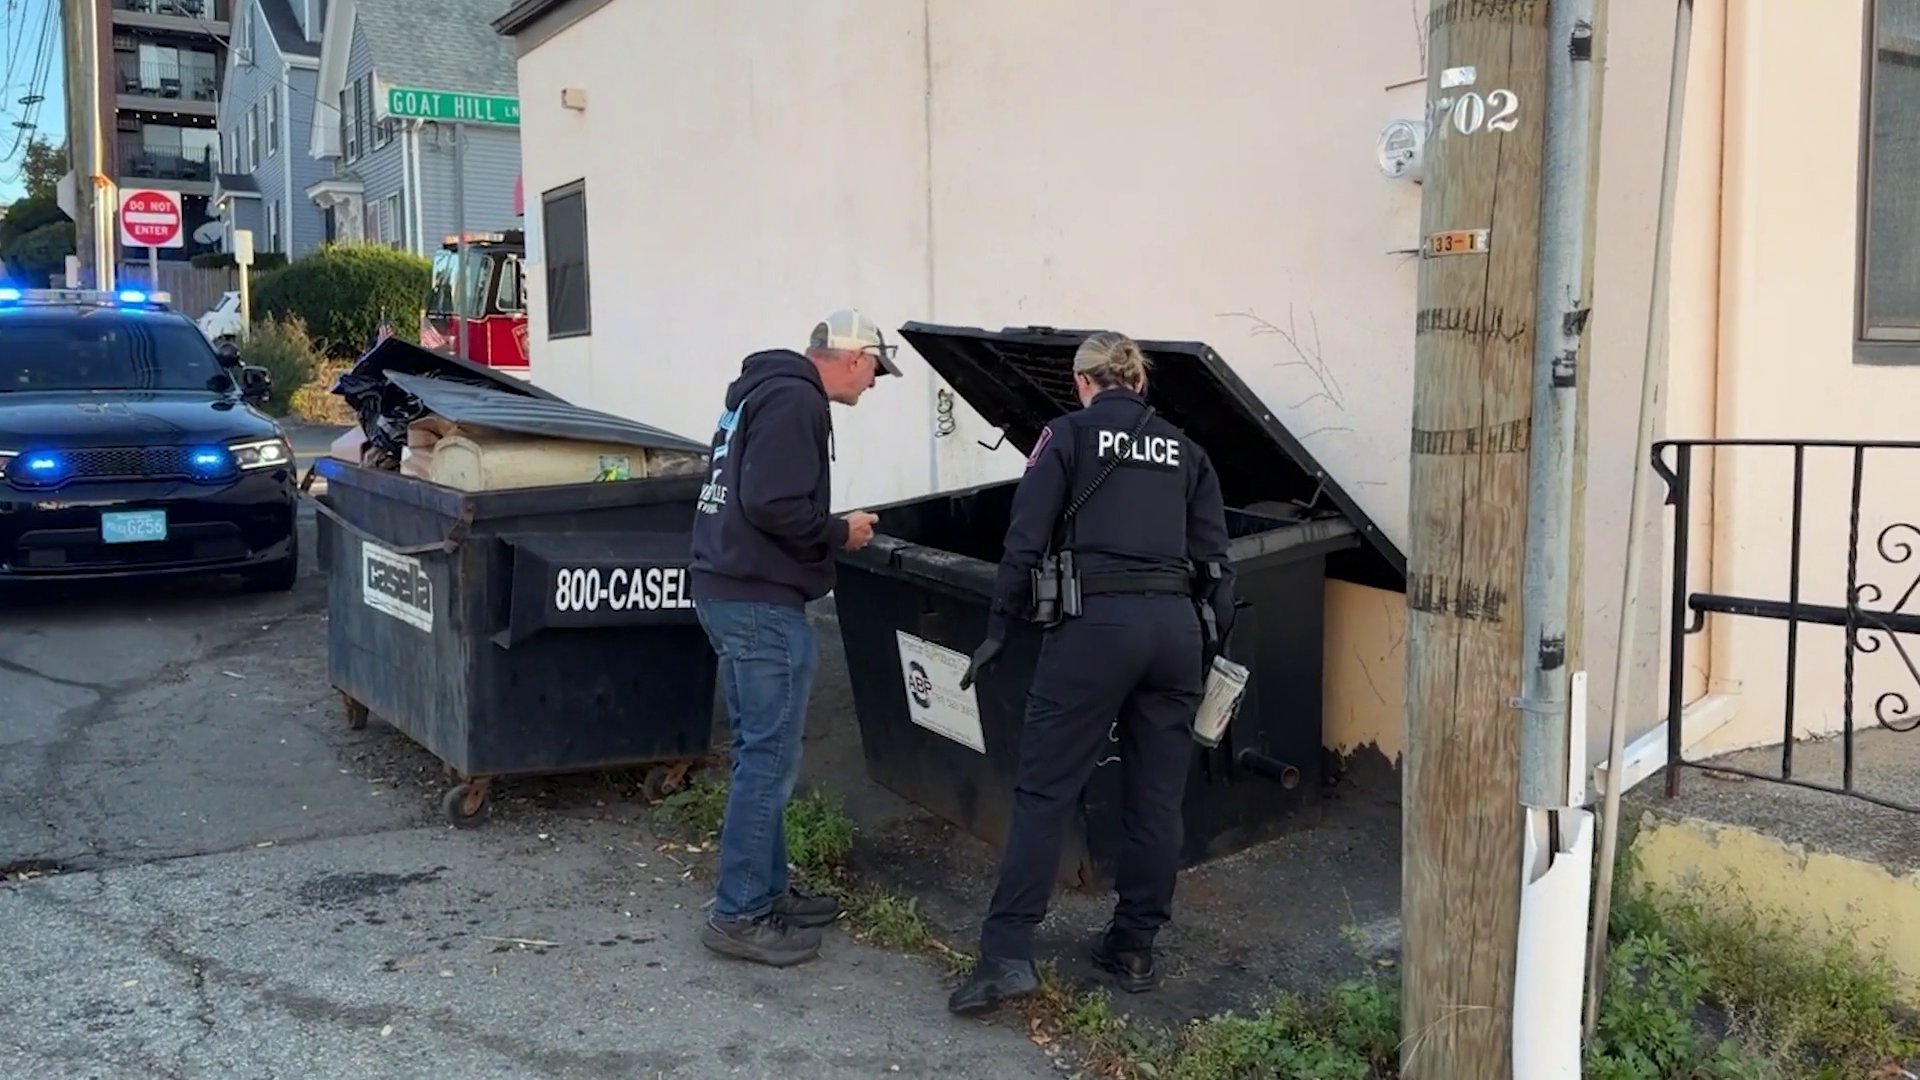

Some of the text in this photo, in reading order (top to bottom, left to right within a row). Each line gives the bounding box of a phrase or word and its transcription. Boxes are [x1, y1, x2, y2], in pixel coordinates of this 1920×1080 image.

[393, 91, 519, 120] GOAT HILL LN
[129, 200, 172, 212] DO NOT
[134, 224, 169, 236] ENTER
[1098, 430, 1180, 466] POLICE
[555, 568, 697, 612] 800-CASEL
[909, 674, 932, 695] ABP
